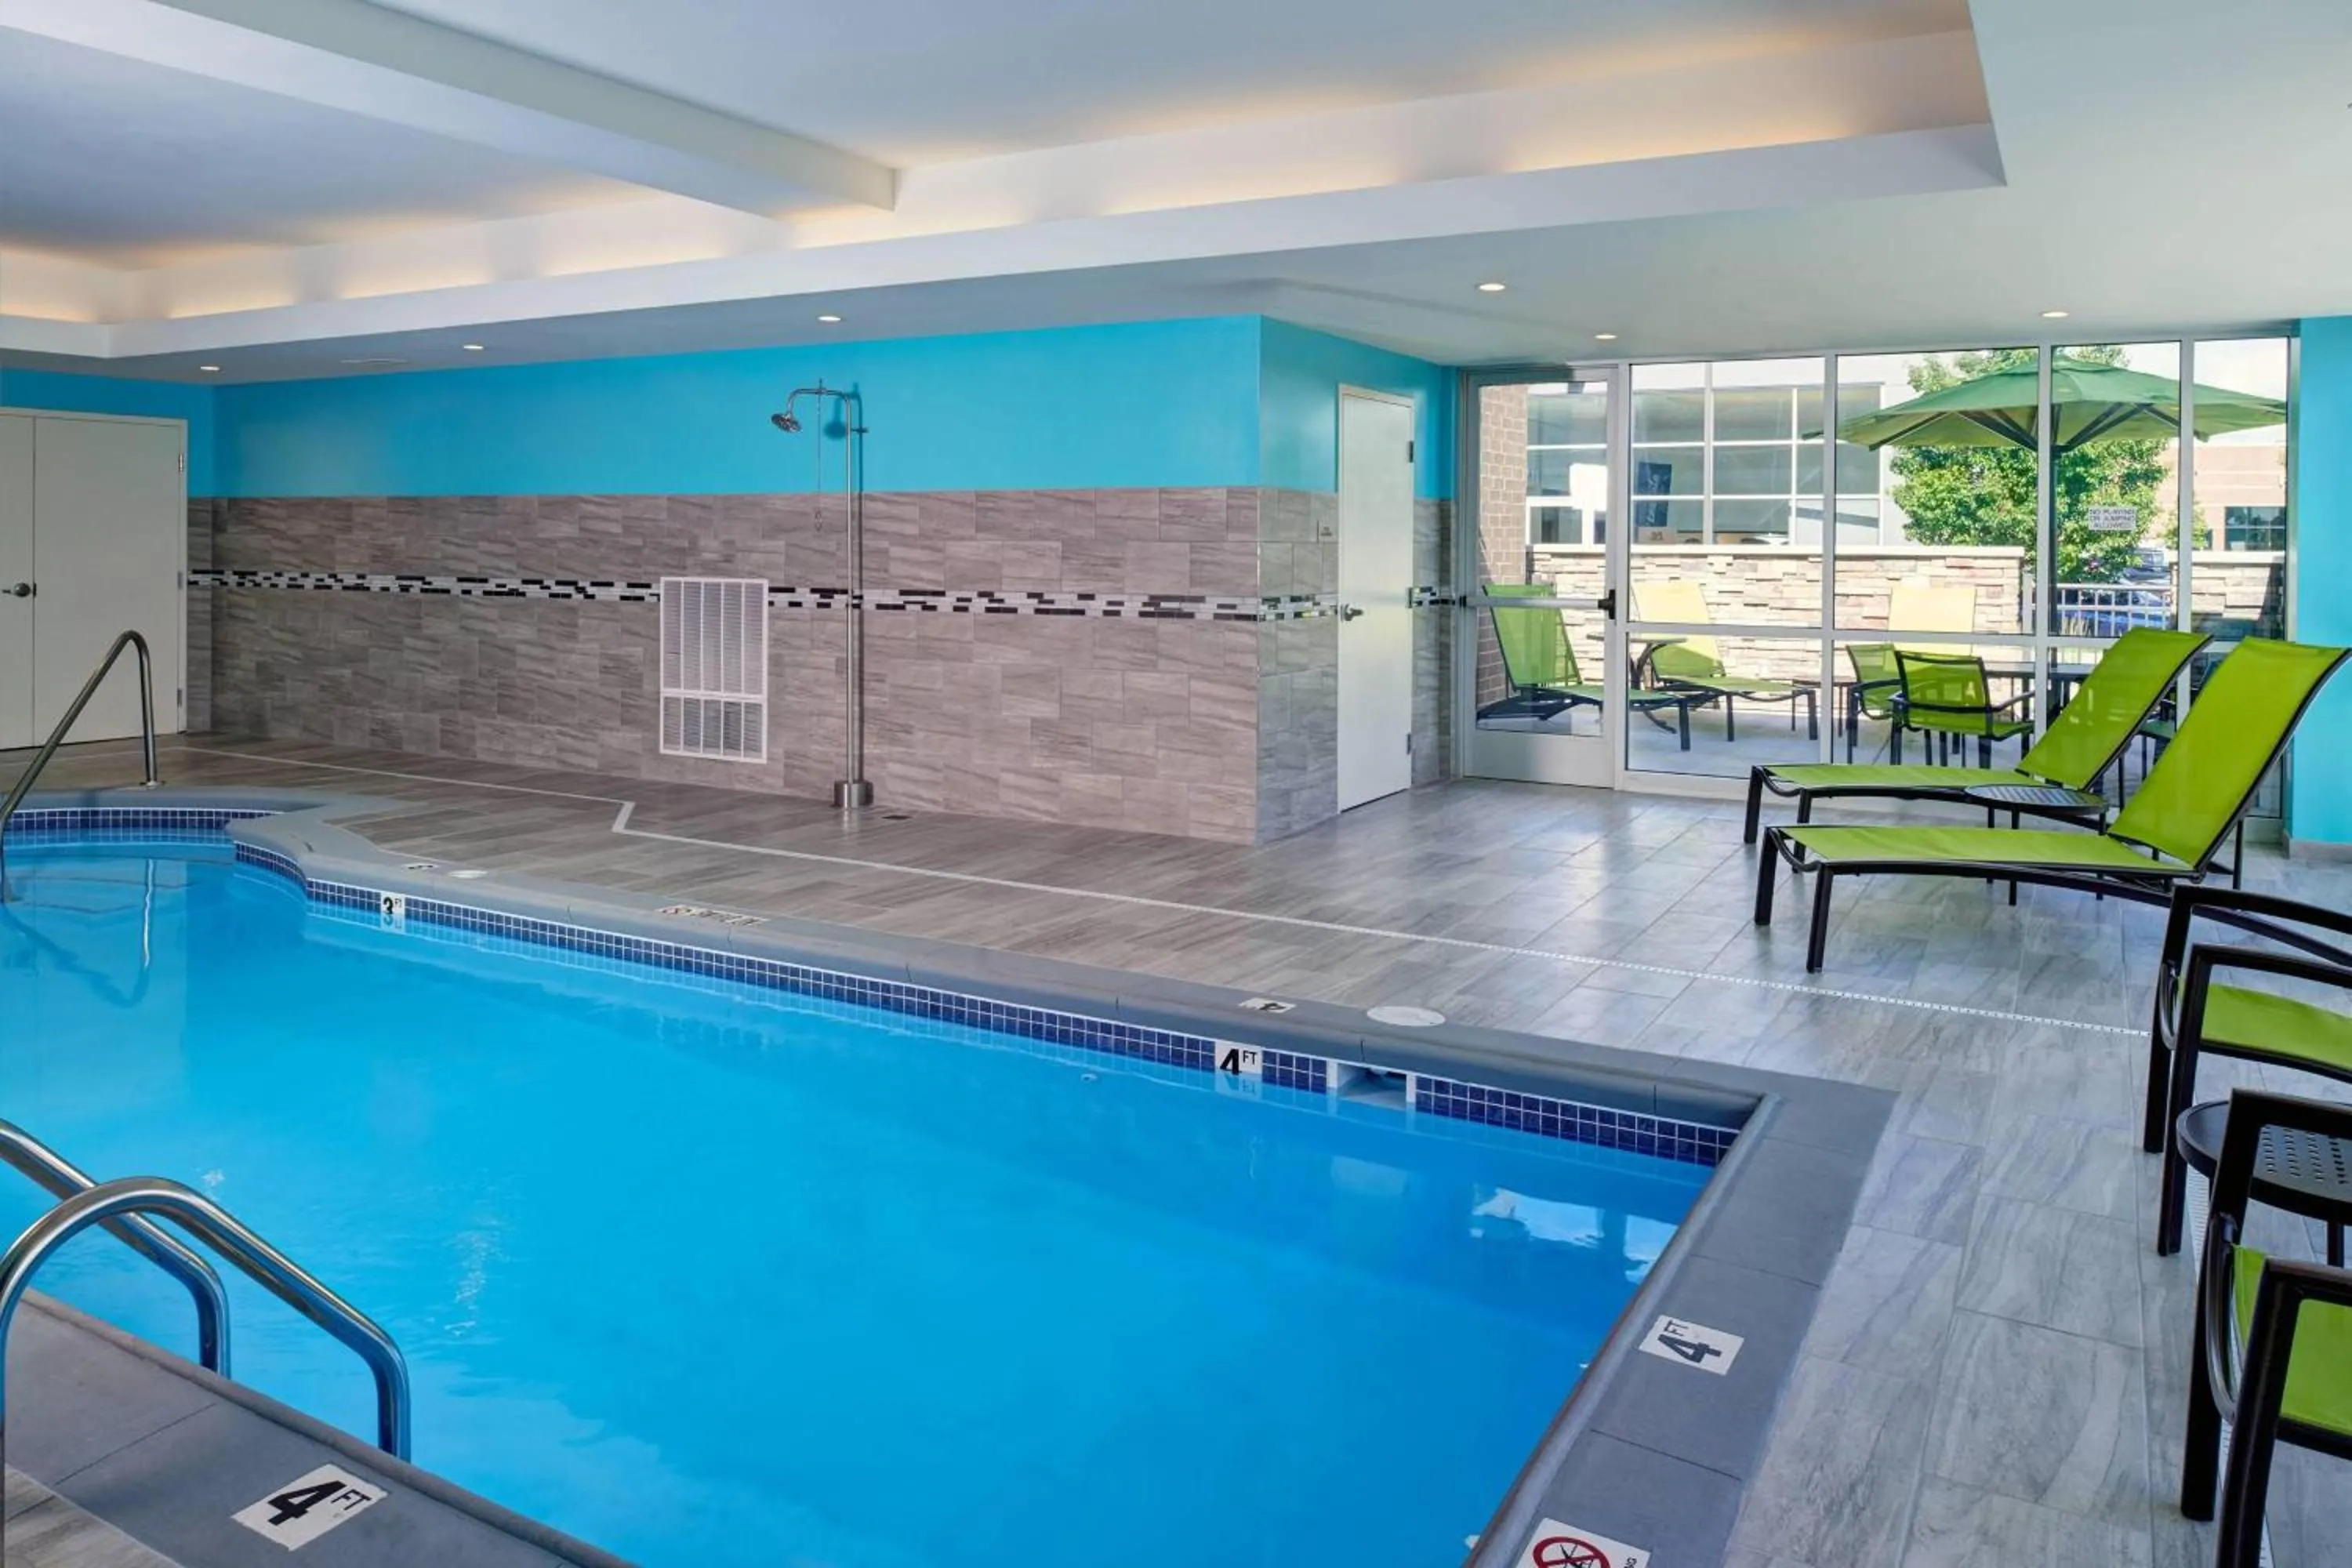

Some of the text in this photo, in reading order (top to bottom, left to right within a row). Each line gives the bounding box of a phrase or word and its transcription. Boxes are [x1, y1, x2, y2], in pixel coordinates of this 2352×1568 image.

[1243, 1050, 1258, 1065] FT
[1657, 1319, 1722, 1363] 4 FT
[267, 1480, 372, 1526] 4 FT
